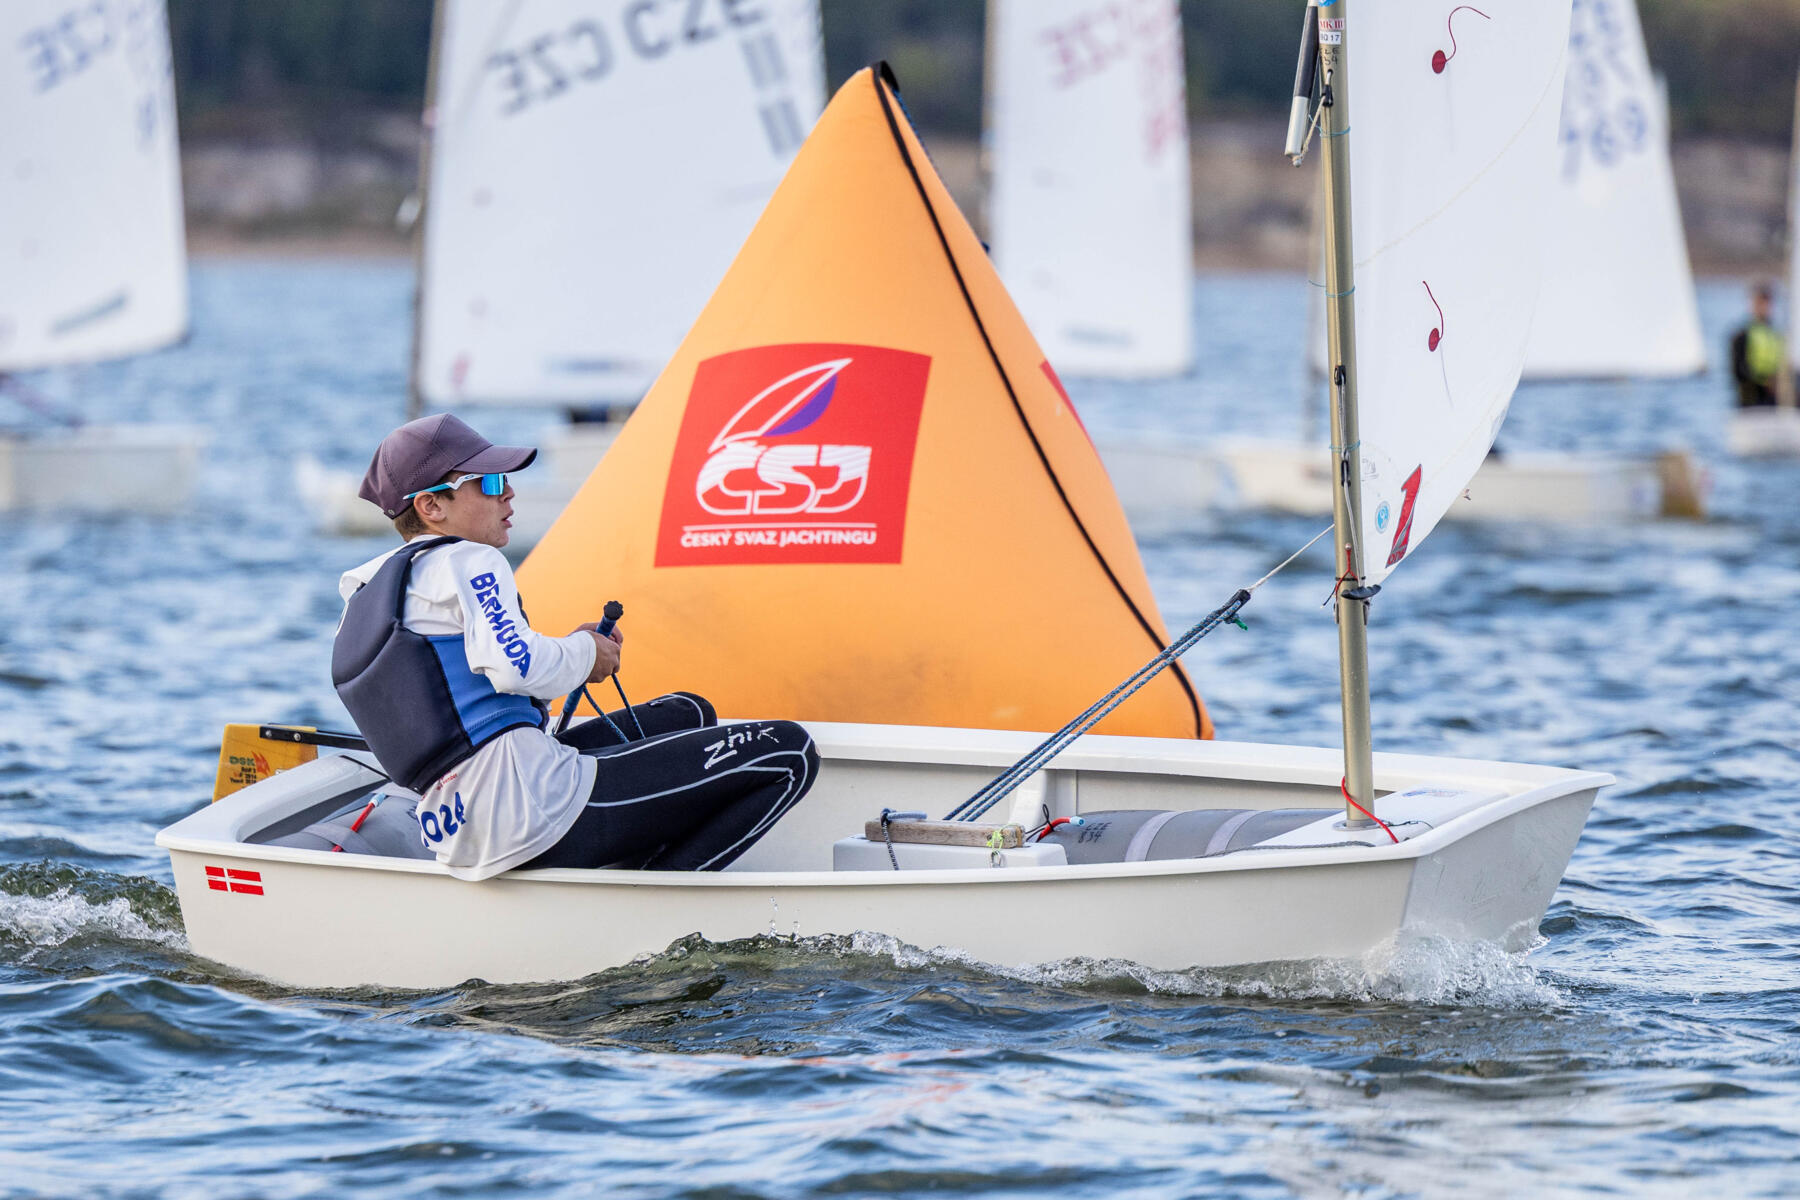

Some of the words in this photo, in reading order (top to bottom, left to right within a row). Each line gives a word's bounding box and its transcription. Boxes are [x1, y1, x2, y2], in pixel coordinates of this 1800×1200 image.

[680, 530, 732, 548] ČESKÝ
[734, 530, 777, 546] SVAZ
[779, 529, 877, 548] JACHTINGU
[470, 572, 531, 679] BERMUDA
[416, 791, 467, 848] 024
